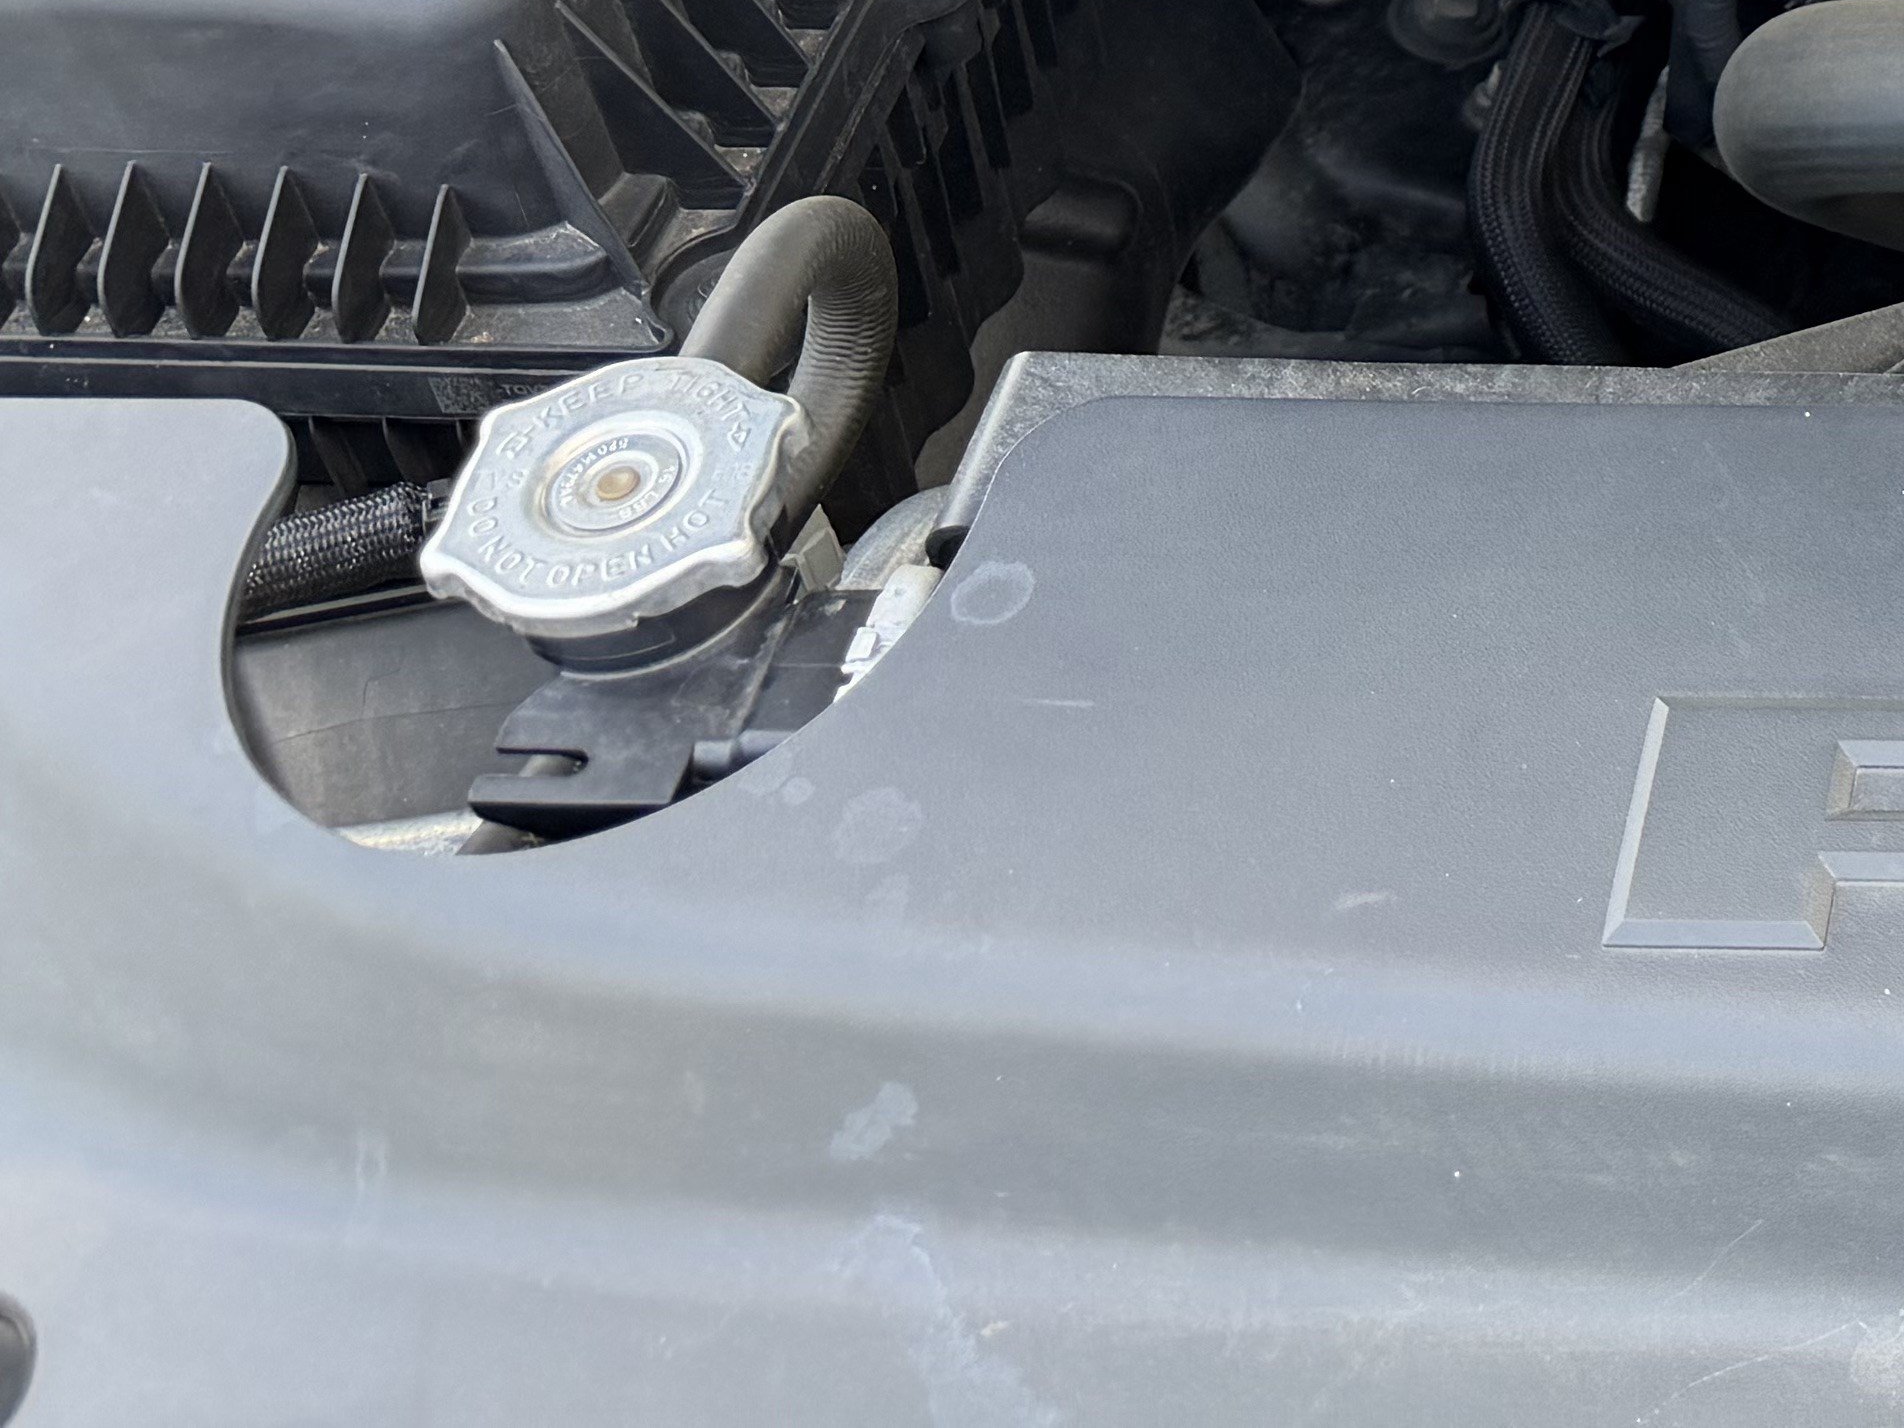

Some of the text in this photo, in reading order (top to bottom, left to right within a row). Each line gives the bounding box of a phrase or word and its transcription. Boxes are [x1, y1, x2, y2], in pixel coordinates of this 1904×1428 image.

[532, 369, 648, 433] KEEP
[670, 368, 755, 430] TIGHT
[465, 489, 728, 589] DO NOT OPEN HOT
